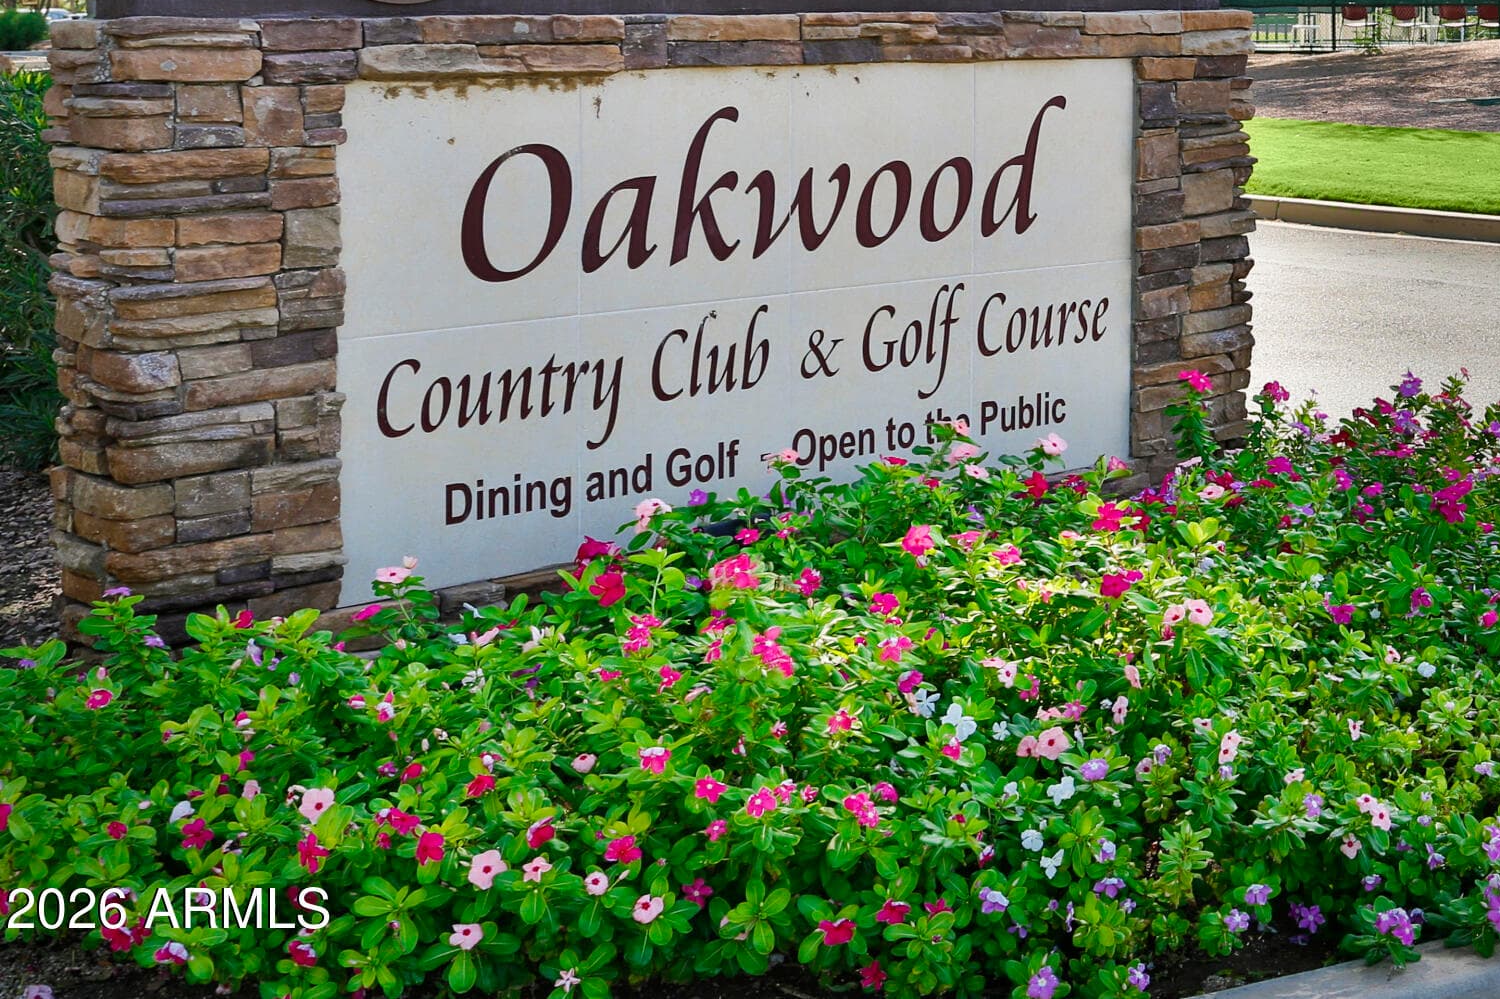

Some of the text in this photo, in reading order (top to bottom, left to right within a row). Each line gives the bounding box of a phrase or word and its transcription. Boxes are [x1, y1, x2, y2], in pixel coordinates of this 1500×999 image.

[460, 95, 1067, 283] Oakwood
[376, 282, 1109, 450] Country Club & Golf Course
[445, 473, 572, 526] Dining
[585, 453, 652, 502] and
[666, 439, 740, 487] Golf
[792, 427, 876, 472] Open
[886, 417, 915, 450] to
[980, 392, 1067, 436] Public
